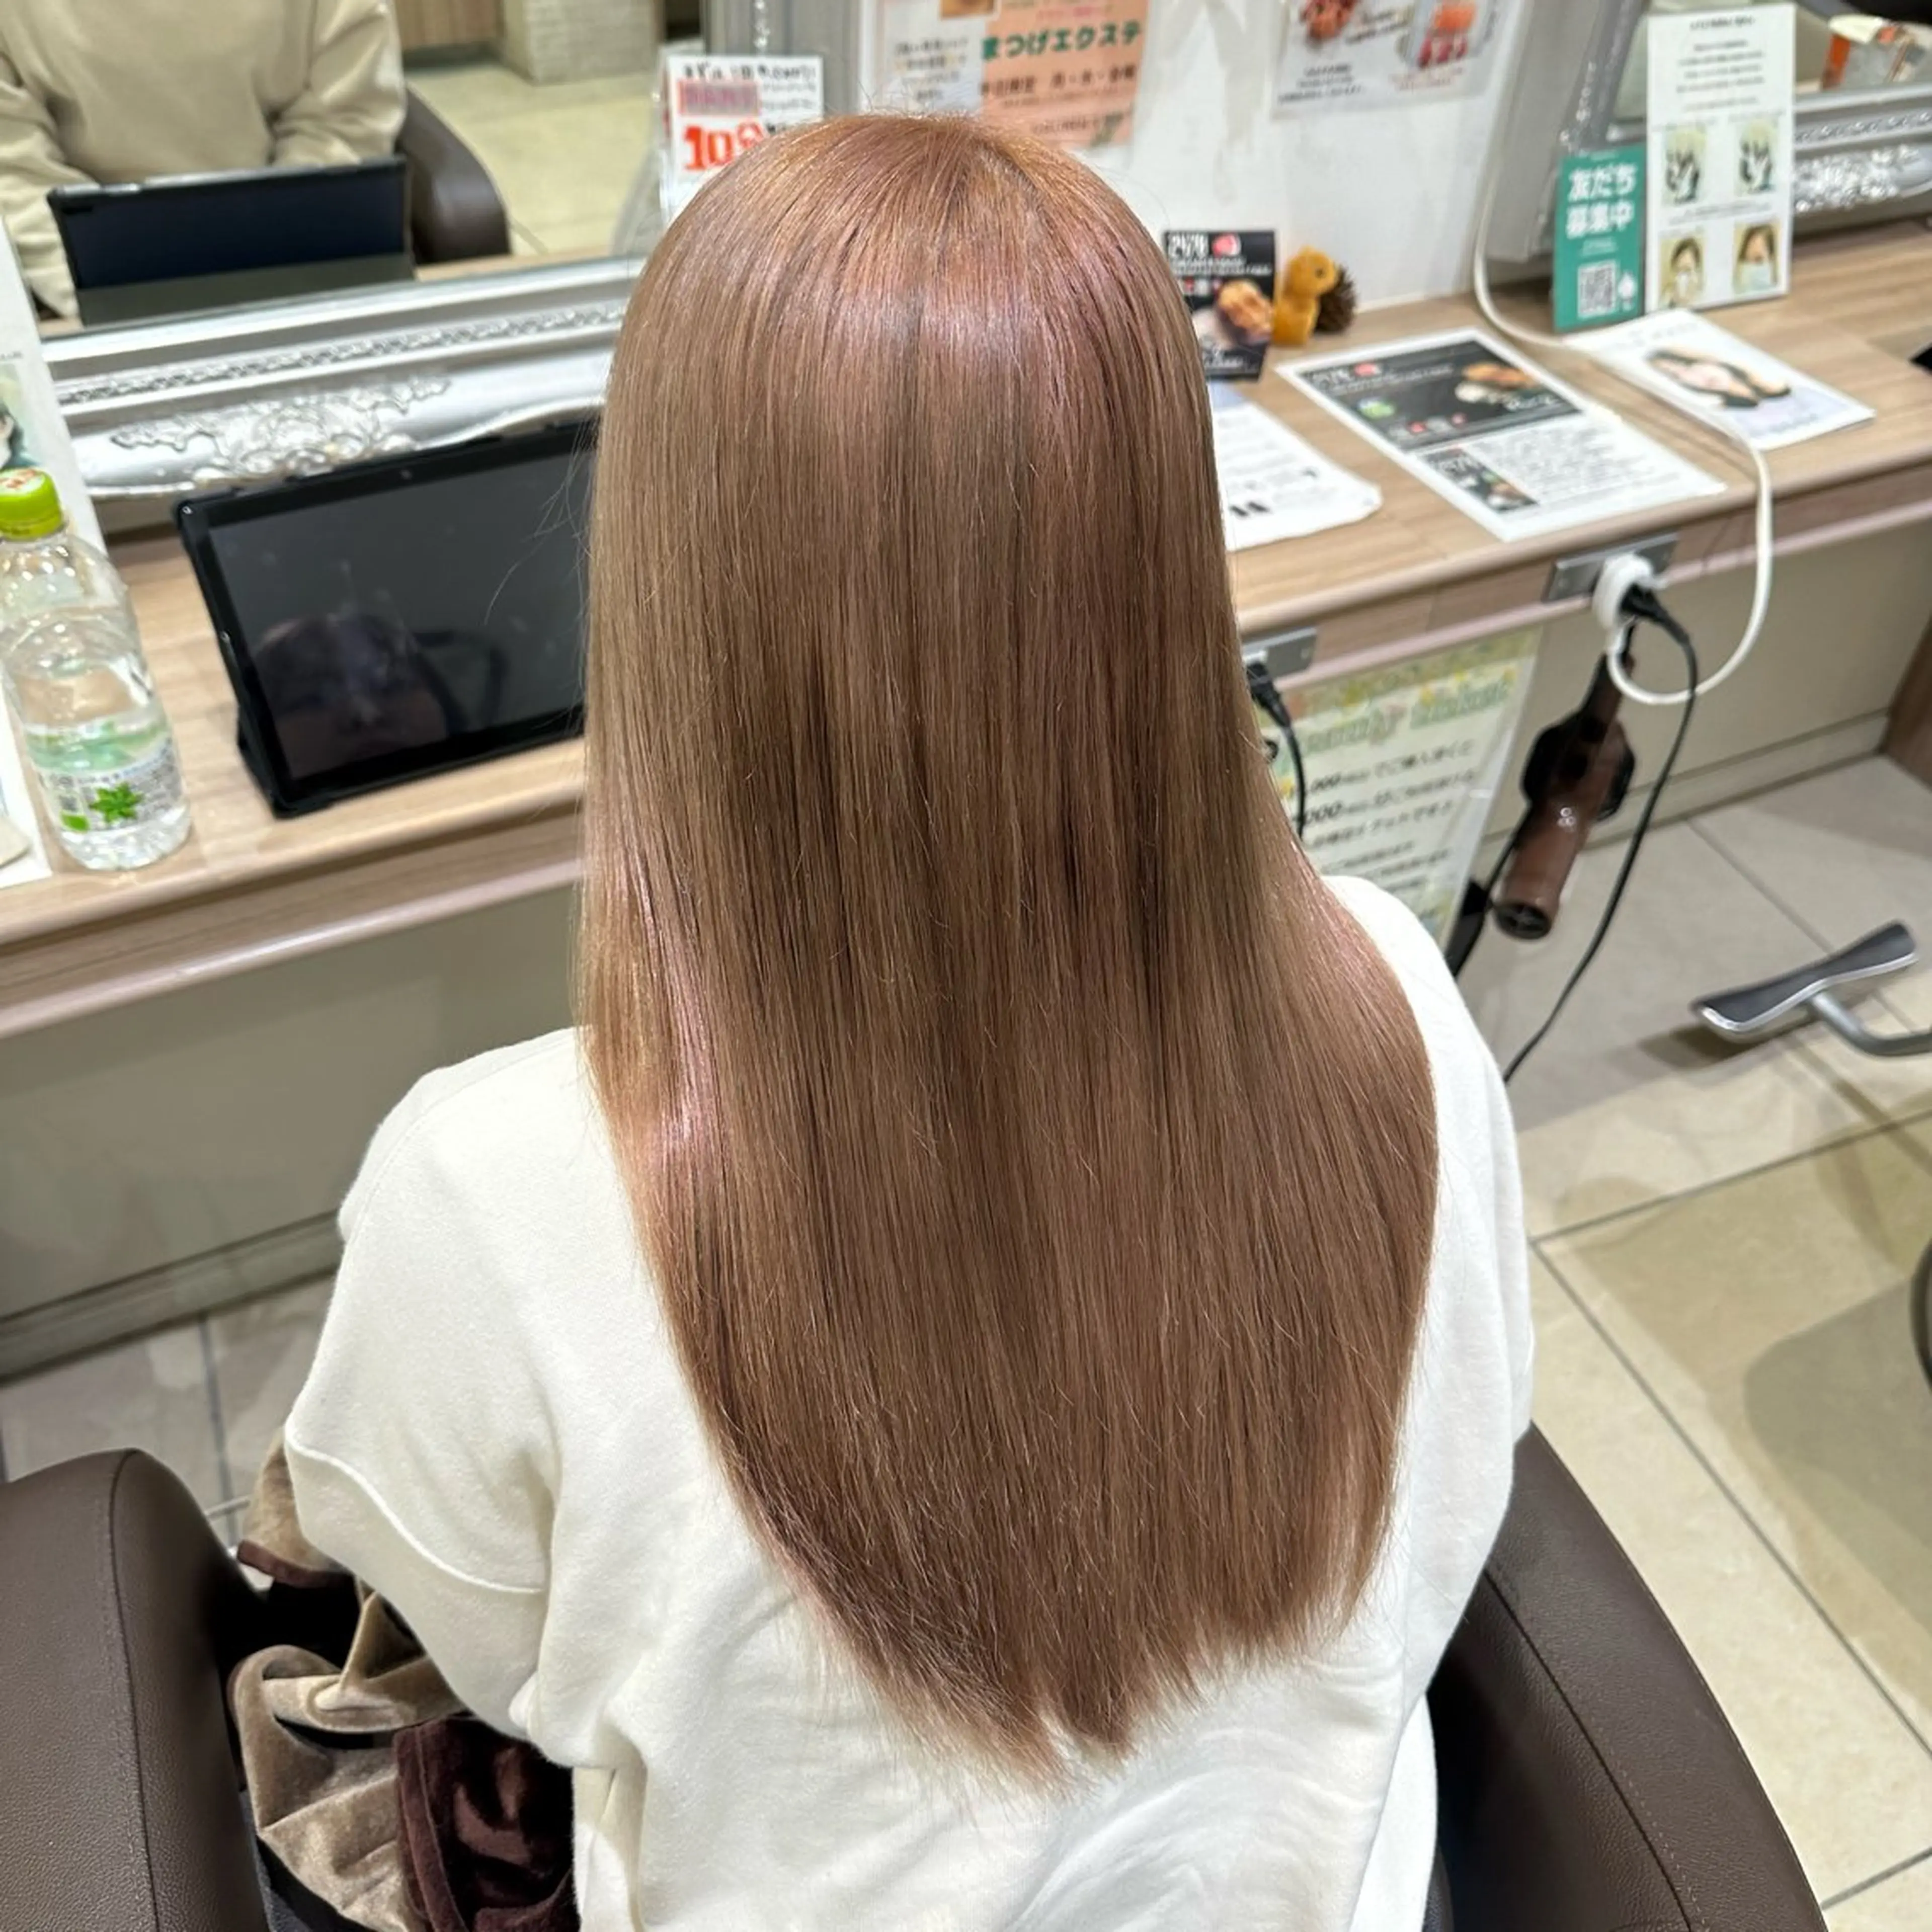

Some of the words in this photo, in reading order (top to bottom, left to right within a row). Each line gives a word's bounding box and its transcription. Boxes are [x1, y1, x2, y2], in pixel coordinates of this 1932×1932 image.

[981, 21, 1140, 61] まつげエクステ
[1567, 162, 1638, 202] 友だち
[1565, 198, 1635, 240] 募集中
